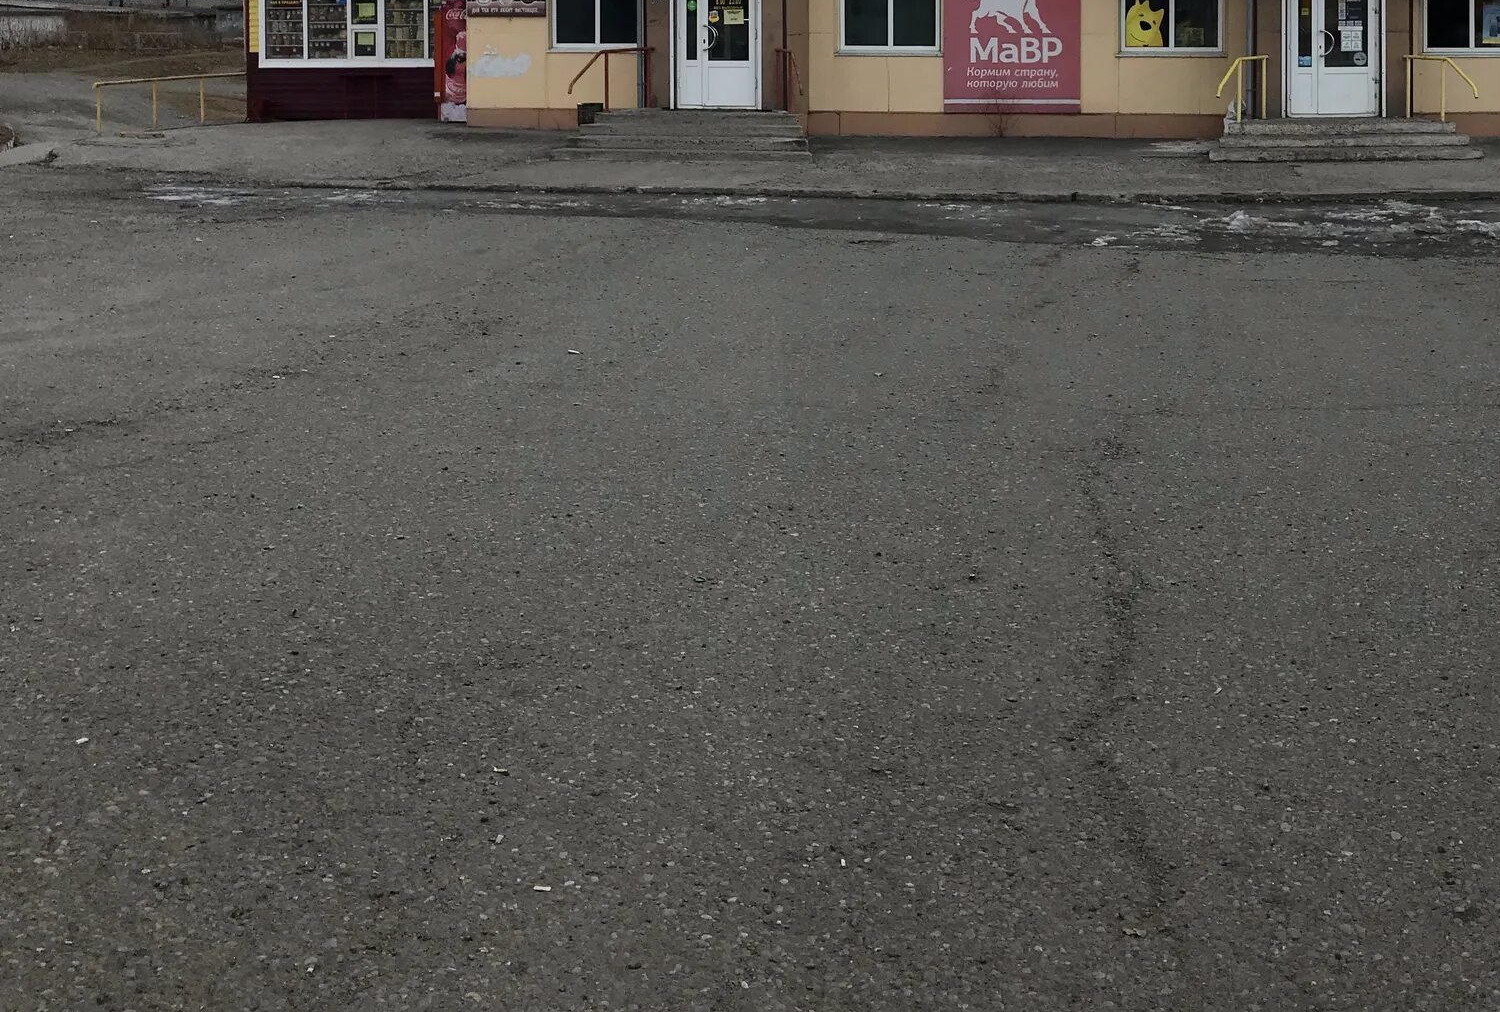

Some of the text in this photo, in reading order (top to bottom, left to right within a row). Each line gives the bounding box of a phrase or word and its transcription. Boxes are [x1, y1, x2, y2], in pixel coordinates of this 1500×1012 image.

[969, 37, 1063, 64] МаВР
[966, 66, 1059, 79] Кормим страну,
[966, 77, 1059, 90] которую любим
